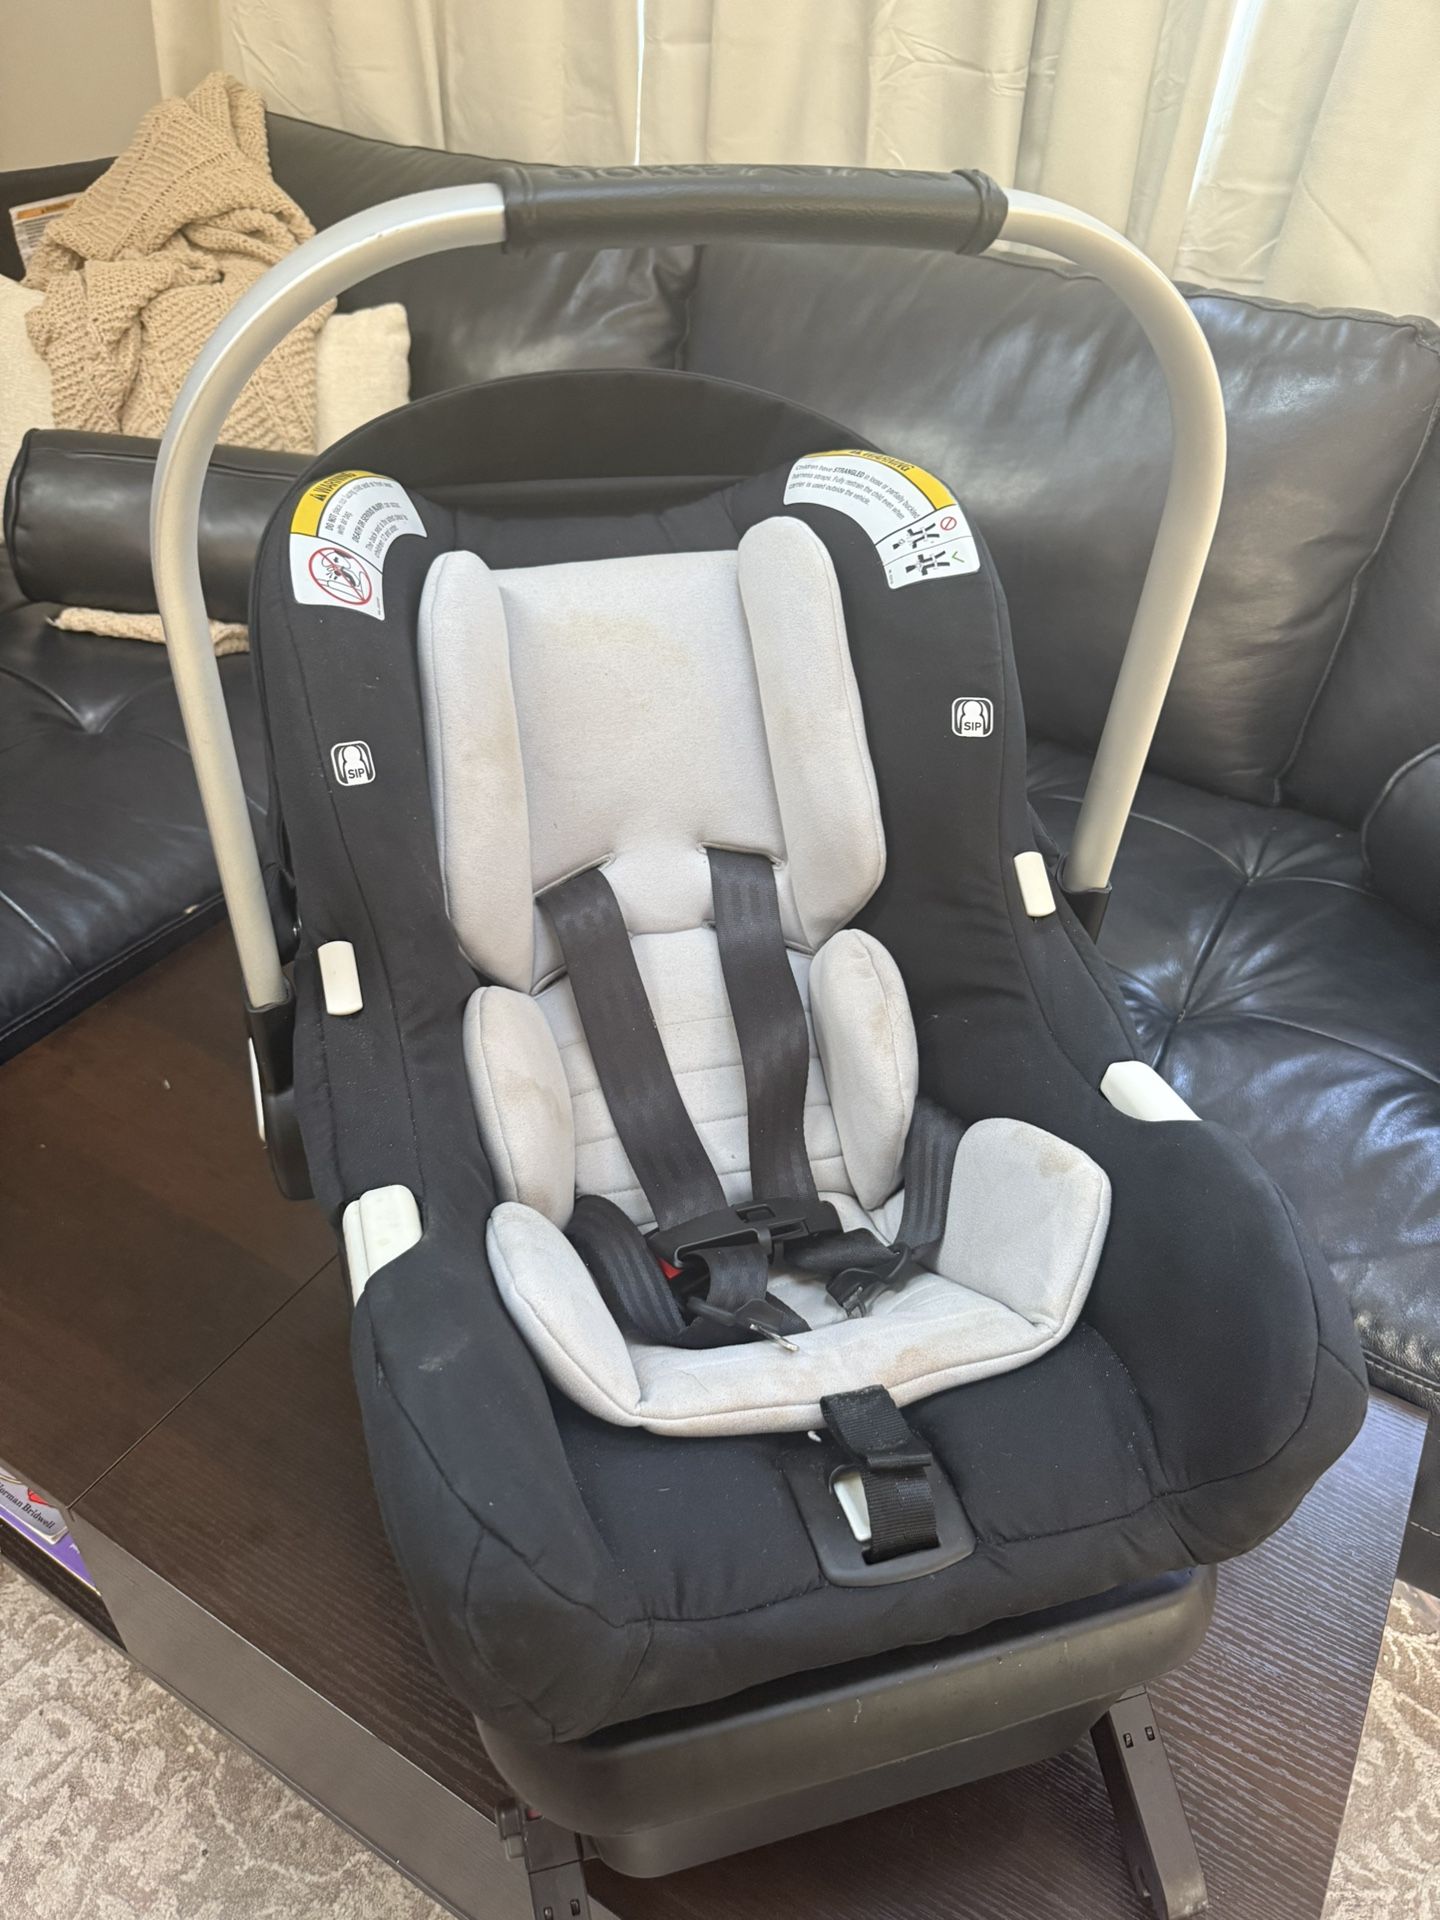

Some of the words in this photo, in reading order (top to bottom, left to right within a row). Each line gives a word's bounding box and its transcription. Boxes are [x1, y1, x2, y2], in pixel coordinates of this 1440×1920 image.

[833, 466, 865, 478] STRANGLED
[964, 722, 982, 731] SIP
[348, 768, 365, 779] SIP
[22, 1503, 56, 1529] Bridwell
